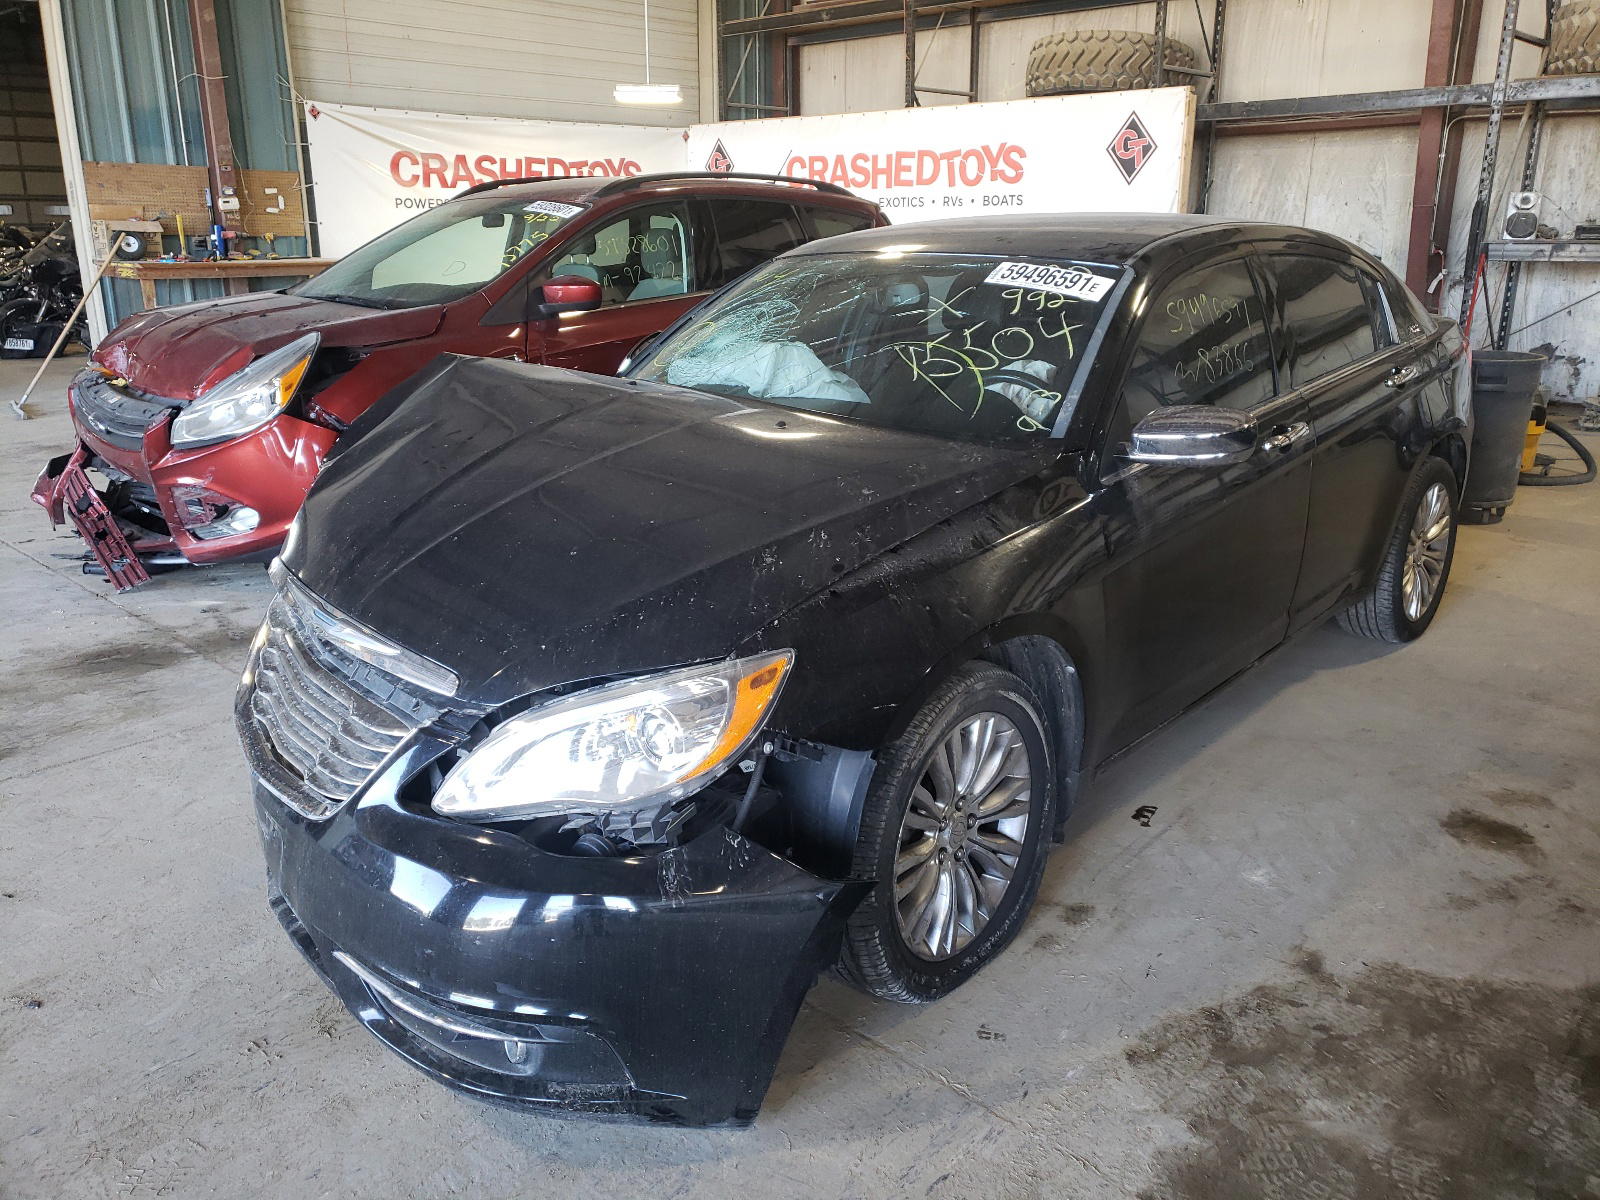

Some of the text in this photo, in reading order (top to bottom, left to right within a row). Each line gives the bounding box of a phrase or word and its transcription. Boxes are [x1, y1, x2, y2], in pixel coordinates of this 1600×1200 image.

[785, 142, 1027, 189] CRASHEDTOYS
[878, 194, 1024, 208] EXOTICS RVs BOATS
[1001, 264, 1094, 292] 59496591
